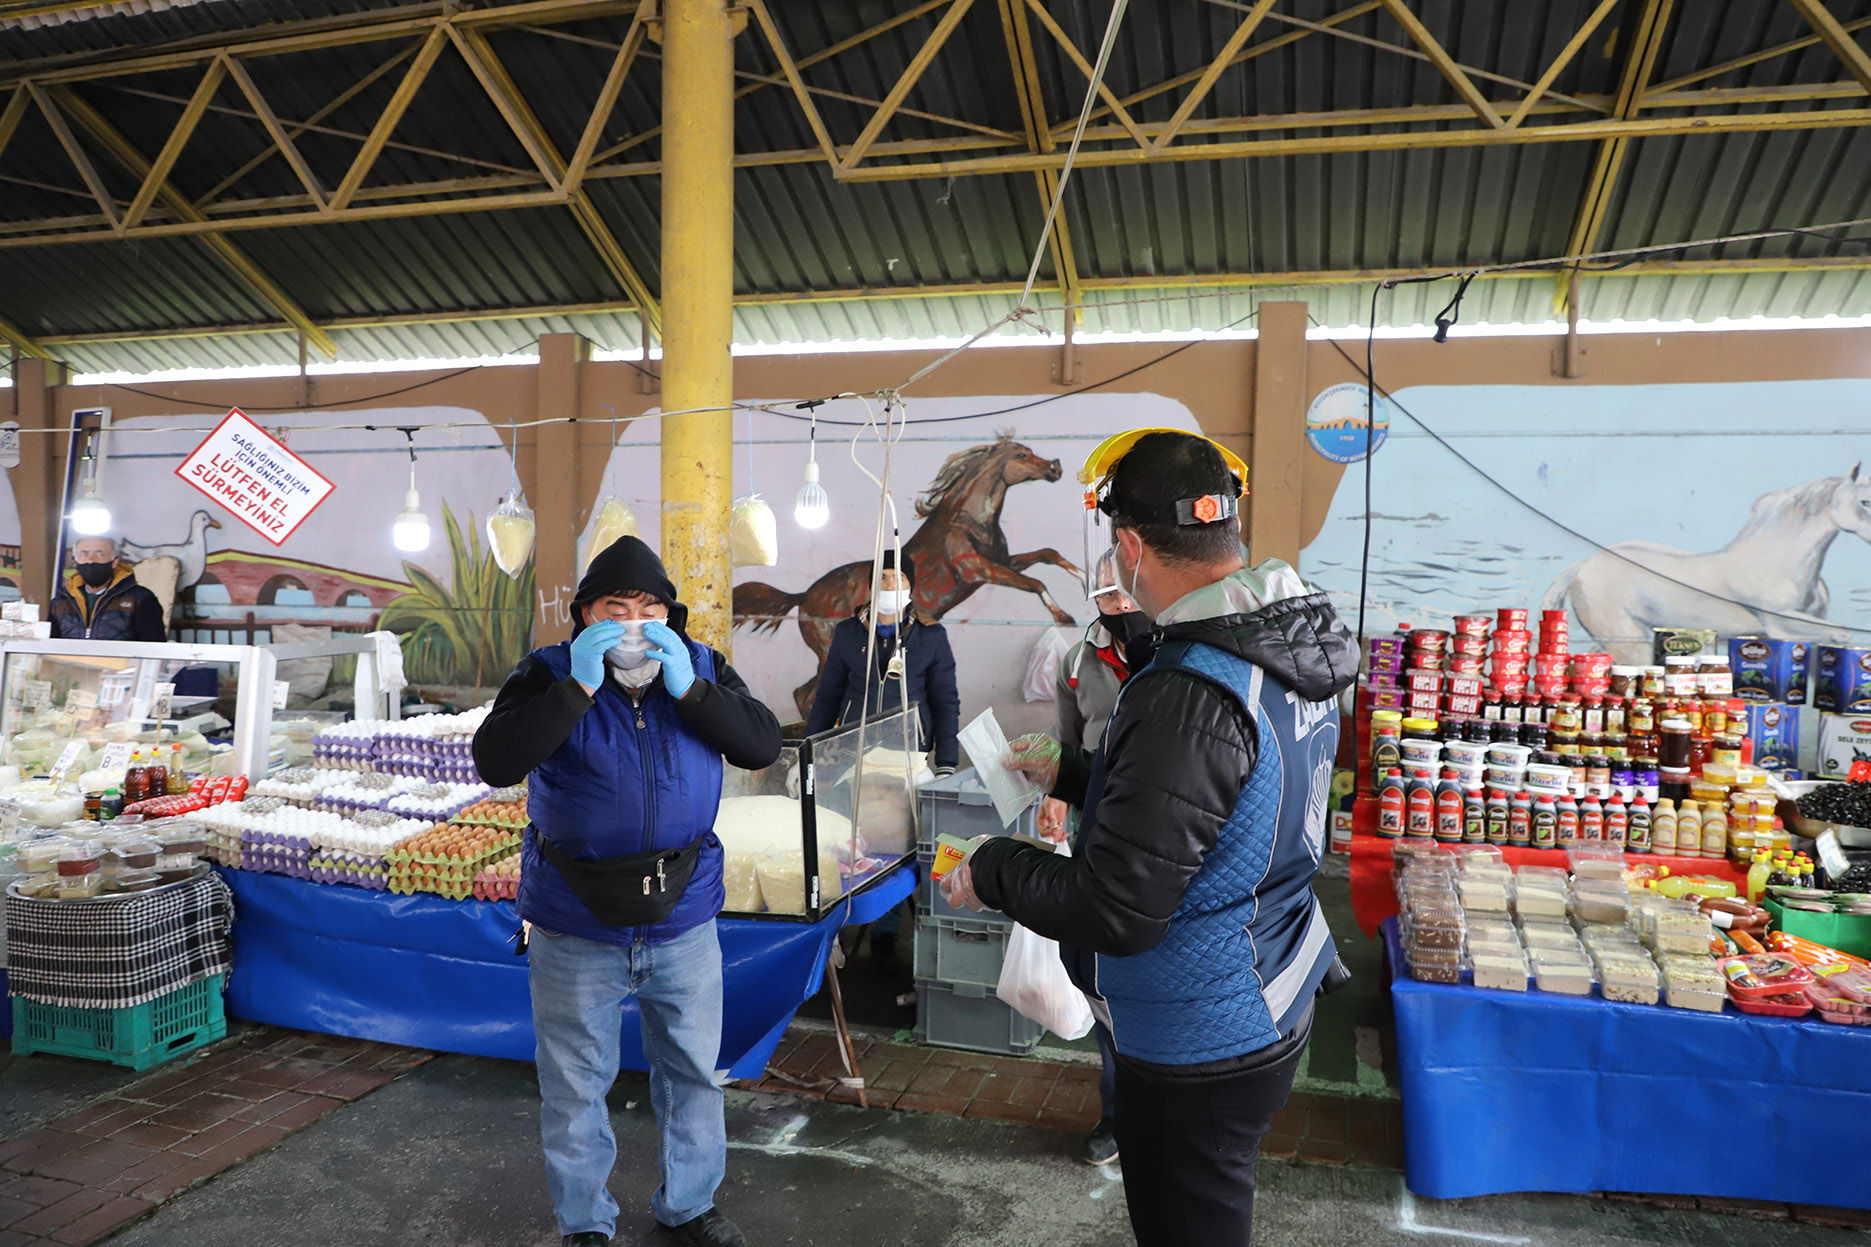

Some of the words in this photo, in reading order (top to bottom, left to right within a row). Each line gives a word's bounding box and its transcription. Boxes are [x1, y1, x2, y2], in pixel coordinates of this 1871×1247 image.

[210, 453, 272, 502] LÜTFEN
[270, 497, 289, 517] EL
[231, 433, 286, 477] SAĞLIĞINIZ
[283, 472, 311, 496] BİZİM
[234, 449, 256, 469] İÇİN
[256, 464, 294, 496] ÖNEMLİ
[192, 464, 285, 534] SÜRMEYİNİZ
